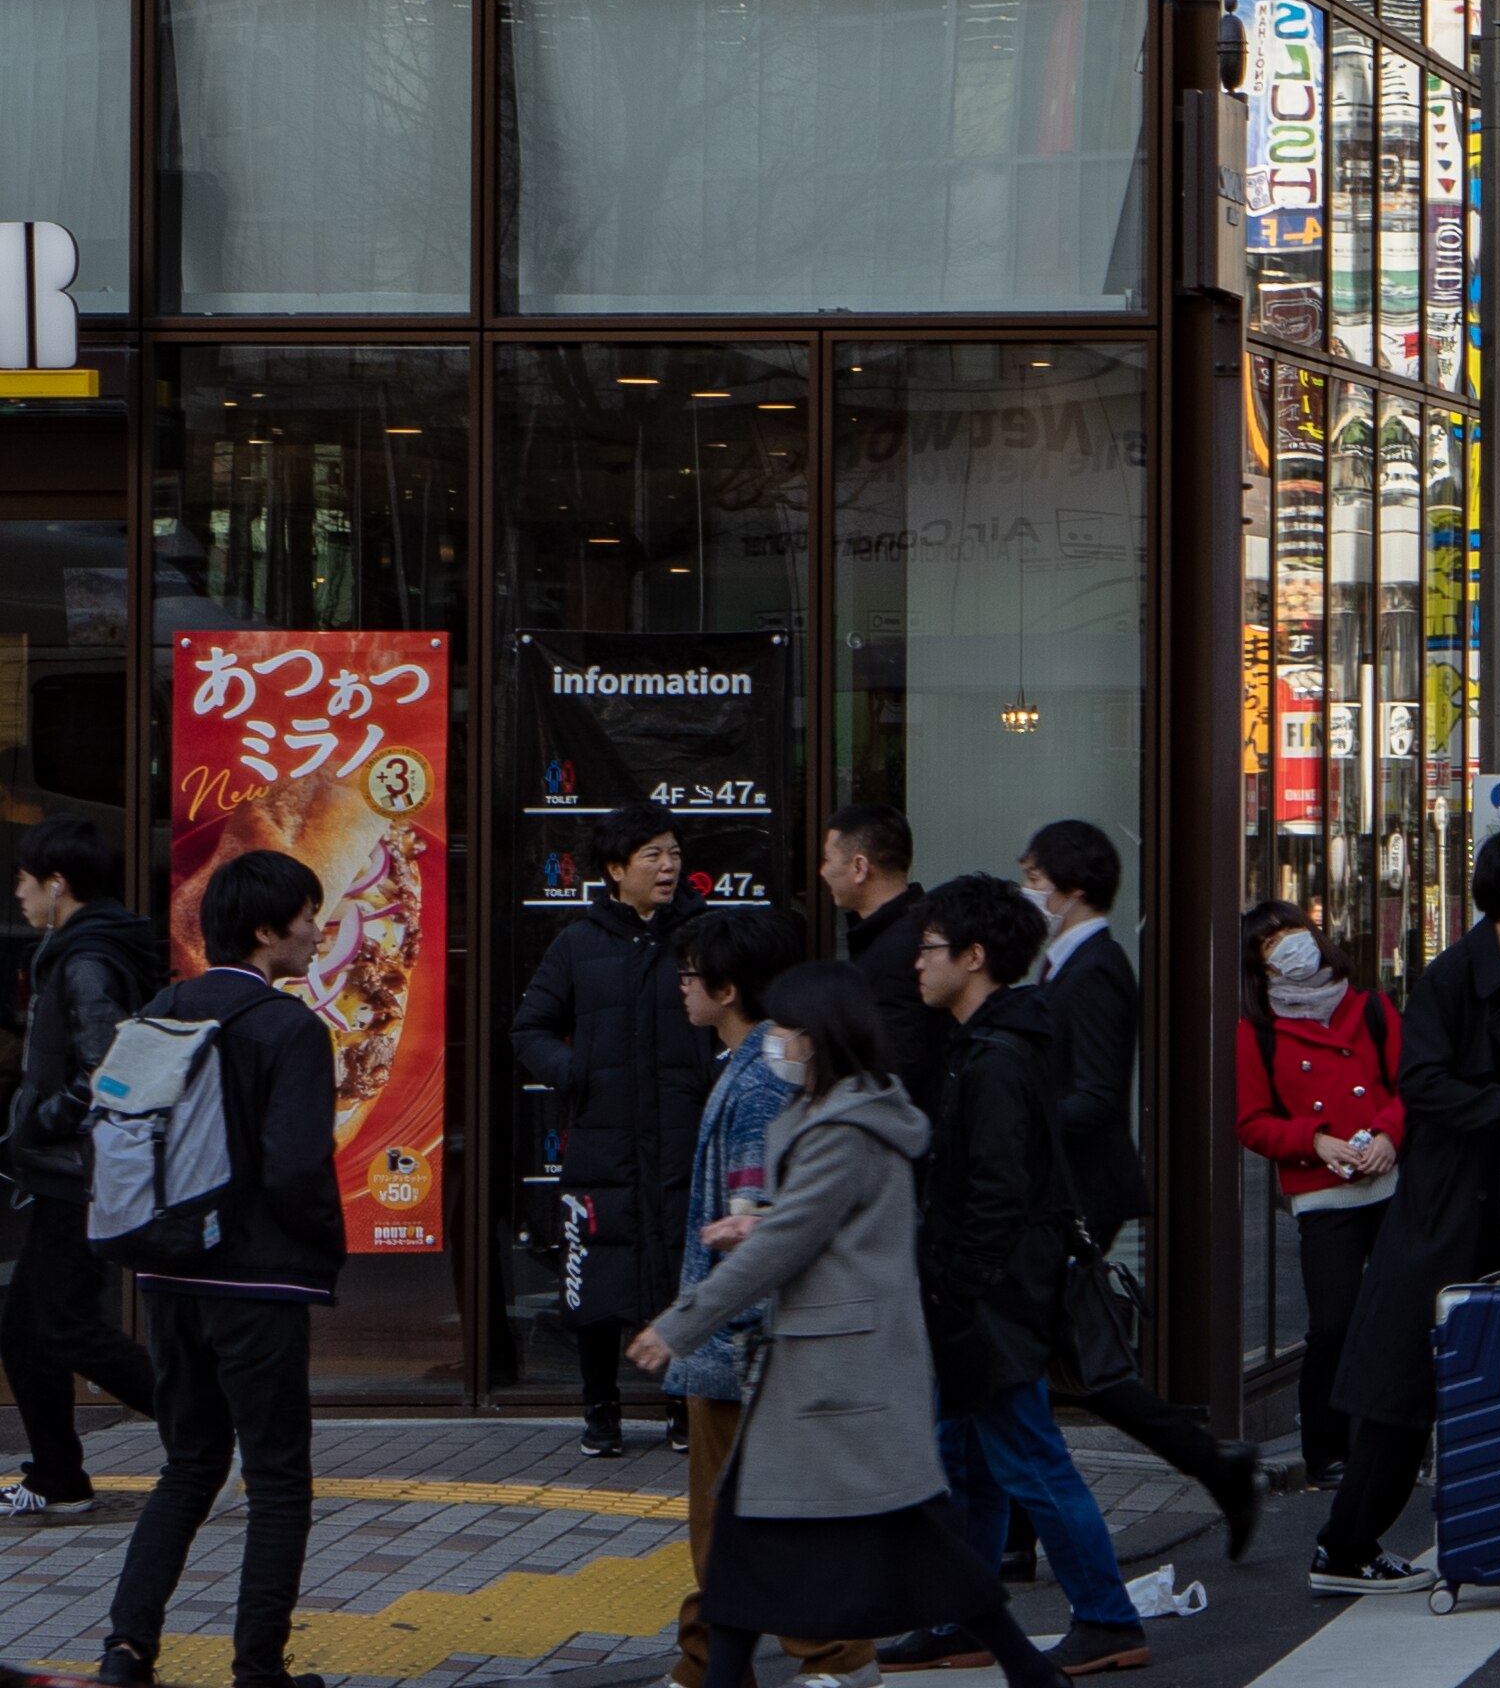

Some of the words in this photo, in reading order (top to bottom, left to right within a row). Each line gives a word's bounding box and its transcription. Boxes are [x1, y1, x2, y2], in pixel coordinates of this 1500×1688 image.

[193, 647, 431, 720] あつあつ
[553, 666, 753, 697] information
[240, 717, 385, 782] ミラノ
[182, 765, 270, 822] New
[545, 796, 578, 805] TOILET
[650, 782, 685, 805] 4F
[544, 888, 578, 898] TOILET
[379, 1182, 414, 1204] ¥50
[374, 1225, 425, 1239] DOUTOR
